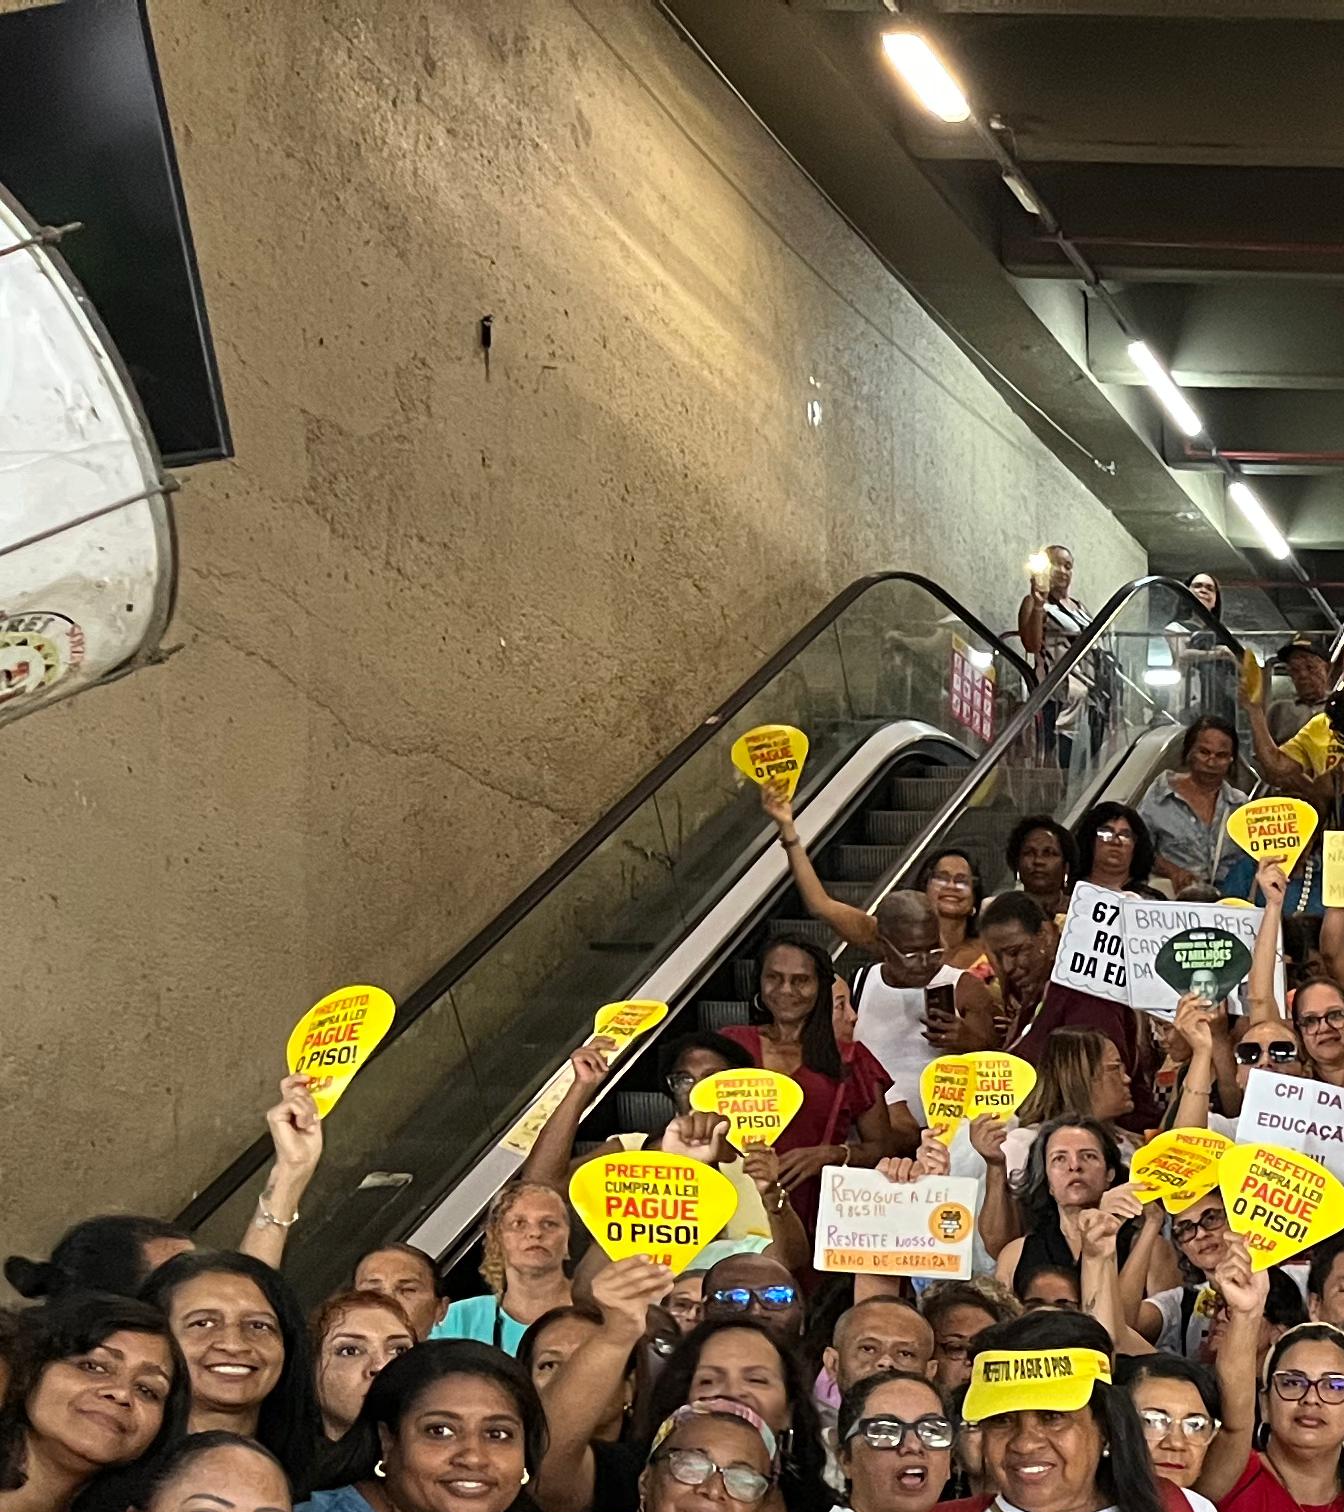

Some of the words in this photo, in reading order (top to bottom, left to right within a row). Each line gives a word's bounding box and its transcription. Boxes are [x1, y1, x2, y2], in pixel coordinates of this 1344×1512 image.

[1248, 821, 1298, 838] PAGUE
[1251, 841, 1259, 851] O
[1263, 836, 1300, 850] PISO!
[1091, 902, 1120, 927] 67
[1070, 952, 1098, 979] DA
[302, 1022, 363, 1053] PAGUE
[295, 1056, 305, 1072] O
[307, 1045, 357, 1070] PISO!
[1275, 1083, 1304, 1101] CPI
[1317, 1091, 1343, 1109] DA
[605, 1181, 659, 1196] CUMPRA
[662, 1183, 671, 1196] A
[831, 1174, 902, 1204] REVOGUE
[910, 1192, 918, 1203] A
[1241, 1176, 1319, 1223] PAGUE
[605, 1196, 698, 1221] PAGUE
[1232, 1197, 1248, 1215] O
[1250, 1205, 1308, 1244] PISO!
[607, 1222, 622, 1241] O
[631, 1223, 698, 1245] PISO!
[895, 1236, 935, 1248] NOSSO
[825, 1252, 863, 1268] PLANO
[873, 1256, 888, 1267] DE
